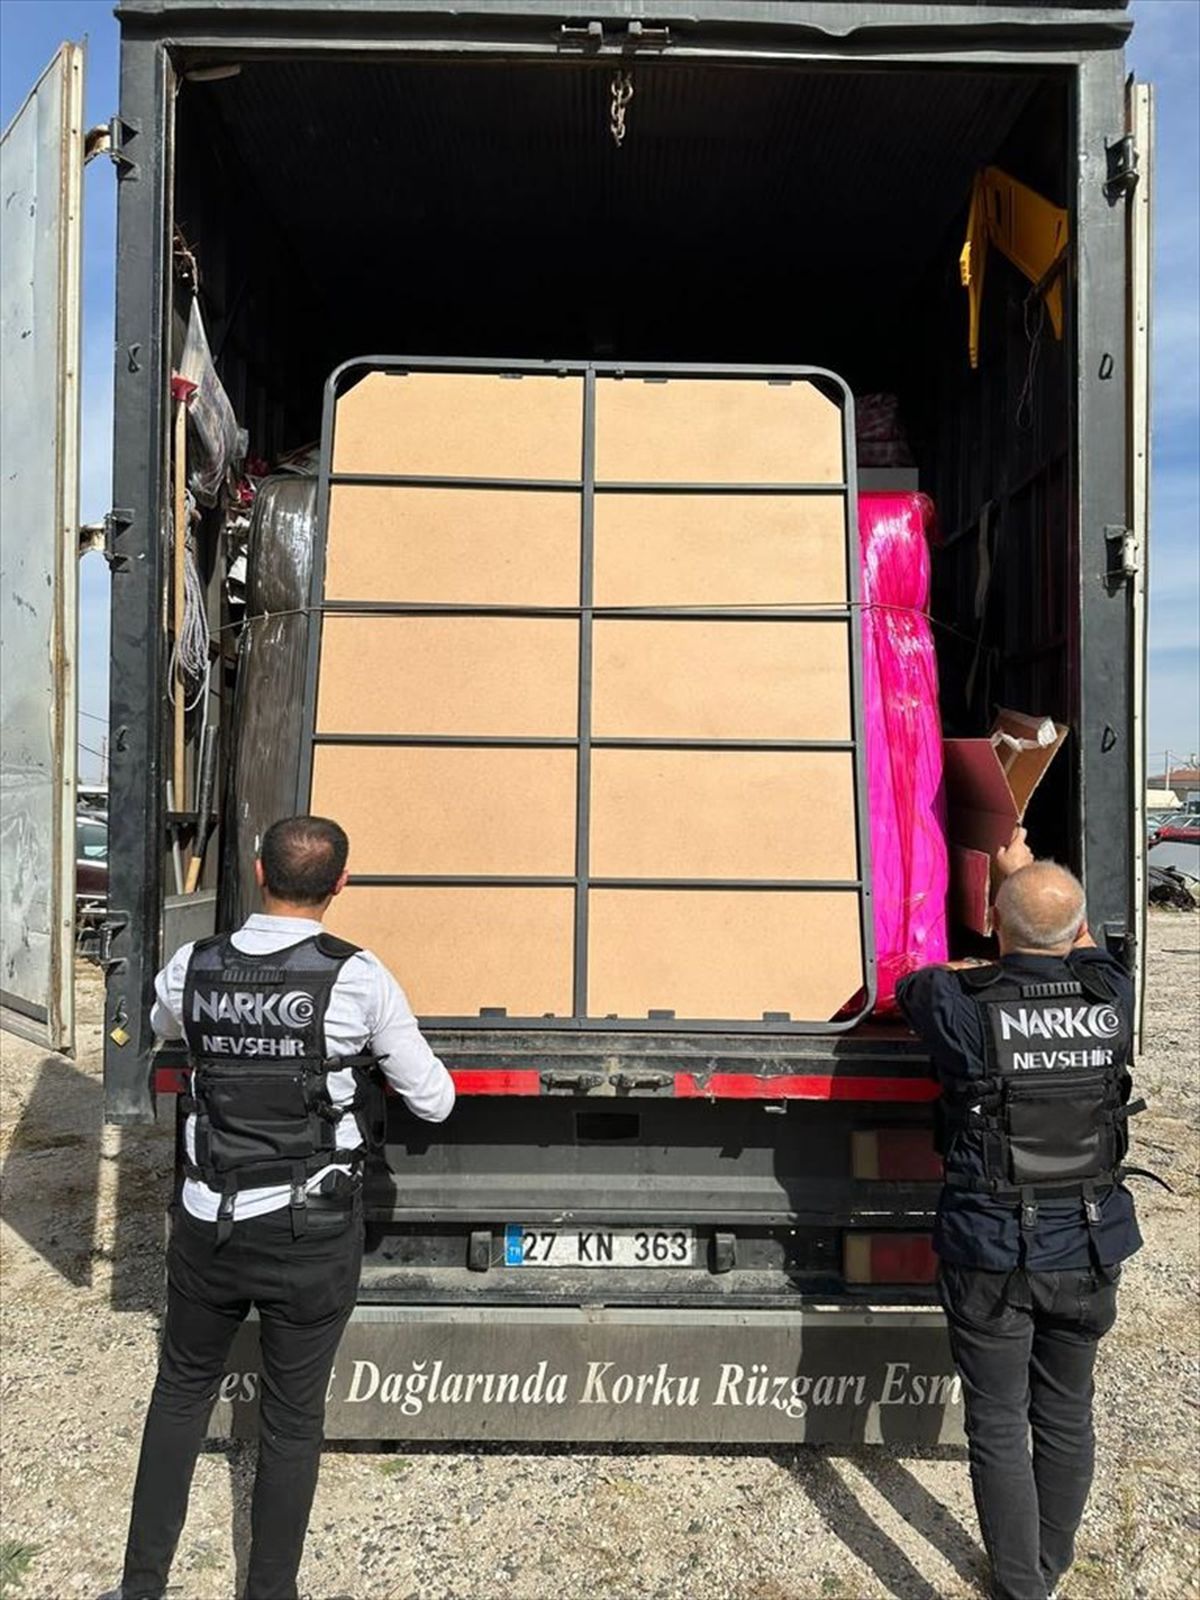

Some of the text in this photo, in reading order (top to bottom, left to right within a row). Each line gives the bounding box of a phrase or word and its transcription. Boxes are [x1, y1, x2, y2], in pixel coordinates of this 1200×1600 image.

[192, 989, 314, 1028] NARKO
[1000, 1004, 1120, 1040] NARKO
[202, 1034, 306, 1057] NEVŞEHİR
[1013, 1045, 1113, 1070] NEVŞEHİR
[523, 1232, 687, 1261] 27 KN 363
[343, 1360, 568, 1416] Dağlarında
[579, 1361, 700, 1406] Korku
[712, 1363, 866, 1418] Rüzgarı
[880, 1362, 962, 1404] Esm
